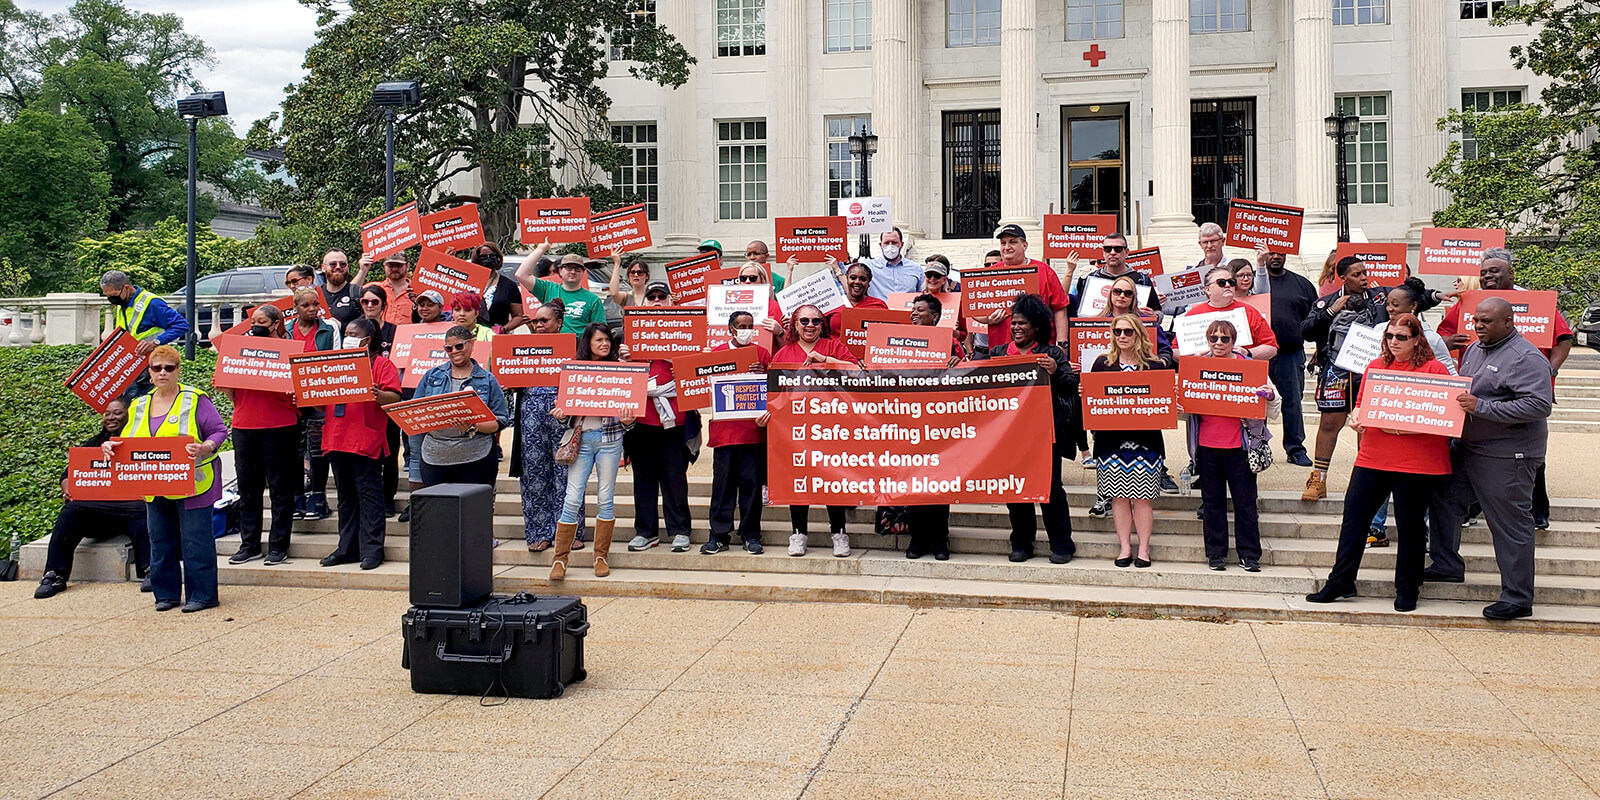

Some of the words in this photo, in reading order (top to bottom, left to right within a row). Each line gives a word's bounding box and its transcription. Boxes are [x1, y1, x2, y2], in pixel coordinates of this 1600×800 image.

[524, 217, 561, 225] Front-line
[1243, 212, 1258, 221] Fair
[1258, 214, 1289, 226] Contract
[423, 228, 455, 241] Front-line
[455, 222, 478, 233] heroes
[557, 224, 586, 233] respect
[1242, 223, 1258, 232] Safe
[1259, 225, 1288, 238] Staffing
[427, 236, 453, 247] deserve
[453, 228, 478, 240] respect
[818, 236, 844, 245] heroes
[1047, 233, 1085, 243] Front-line
[1240, 234, 1268, 247] Protect
[1268, 238, 1294, 248] Donors
[813, 244, 842, 252] respect
[1050, 241, 1080, 251] deserve
[437, 265, 449, 274] Red
[449, 269, 468, 280] Cross:
[418, 276, 448, 291] deserve
[419, 268, 454, 285] Front-line
[455, 279, 481, 294] heroes
[975, 279, 990, 288] Fair
[991, 278, 1025, 287] Contract
[782, 287, 802, 299] Exposed
[807, 279, 821, 287] Covid
[976, 290, 994, 299] Safe
[786, 299, 808, 310] American
[818, 287, 832, 296] Cross
[978, 301, 1006, 310] Protect
[640, 320, 656, 328] Fair
[657, 320, 692, 328] Contract
[1514, 314, 1549, 326] heroes
[641, 331, 659, 340] Safe
[660, 331, 692, 341] Staffing
[1356, 331, 1381, 343] Exposed
[905, 339, 928, 347] Cross:
[257, 351, 279, 359] Cross:
[870, 346, 914, 357] Front-line
[915, 349, 946, 359] heroes
[1346, 350, 1367, 360] Forced
[1350, 344, 1377, 357] American
[222, 357, 265, 368] Front-line
[266, 360, 291, 370] heroe
[306, 365, 321, 374] Fair
[322, 363, 356, 373] Contract
[223, 365, 258, 376] deserve
[259, 370, 292, 379] respect
[698, 367, 713, 375] Red
[713, 364, 736, 373] Cross:
[308, 377, 326, 386] Safe
[327, 375, 358, 385] Staffing
[577, 375, 594, 383] Fair
[595, 375, 633, 384] Contract
[778, 376, 801, 386] Red
[803, 376, 839, 386] Cross:
[841, 376, 896, 386] Front-line
[899, 376, 939, 386] heroes
[941, 373, 990, 386] deserve
[992, 369, 1038, 384] respect
[1203, 371, 1217, 380] Red
[1218, 373, 1242, 381] Cross:
[310, 388, 339, 398] Protect
[339, 387, 368, 396] Donors
[576, 386, 596, 396] Safe
[597, 387, 632, 398] Staffing
[1182, 379, 1227, 392] Front-line
[1229, 383, 1257, 396] heroe
[1383, 385, 1403, 395] Fair
[1404, 387, 1449, 400] Contract
[1087, 396, 1135, 406] Front-line
[1137, 396, 1172, 405] heroes
[1184, 389, 1221, 400] deserve
[1222, 394, 1259, 404] respect
[575, 399, 607, 408] Protect
[810, 398, 848, 414] Safe
[851, 398, 922, 418] working
[926, 395, 1019, 414] conditions
[1381, 398, 1403, 408] Safe
[1404, 400, 1446, 415] Staffing
[1090, 406, 1130, 415] deserve
[1132, 405, 1169, 416] respect
[1378, 411, 1415, 423] Protect
[1416, 415, 1454, 428] Donors
[811, 424, 850, 440] Safe
[854, 423, 920, 444] staffing
[924, 423, 977, 440] levels
[811, 451, 875, 467] Protect
[878, 451, 940, 467] donors
[116, 462, 158, 471] Front-line
[159, 462, 190, 471] heroes
[75, 478, 112, 487] deserve
[118, 472, 153, 481] deserve
[154, 472, 188, 482] respect
[812, 477, 875, 494] Protect
[879, 477, 908, 494] the
[910, 476, 961, 493] blood
[966, 475, 1025, 495] supply
